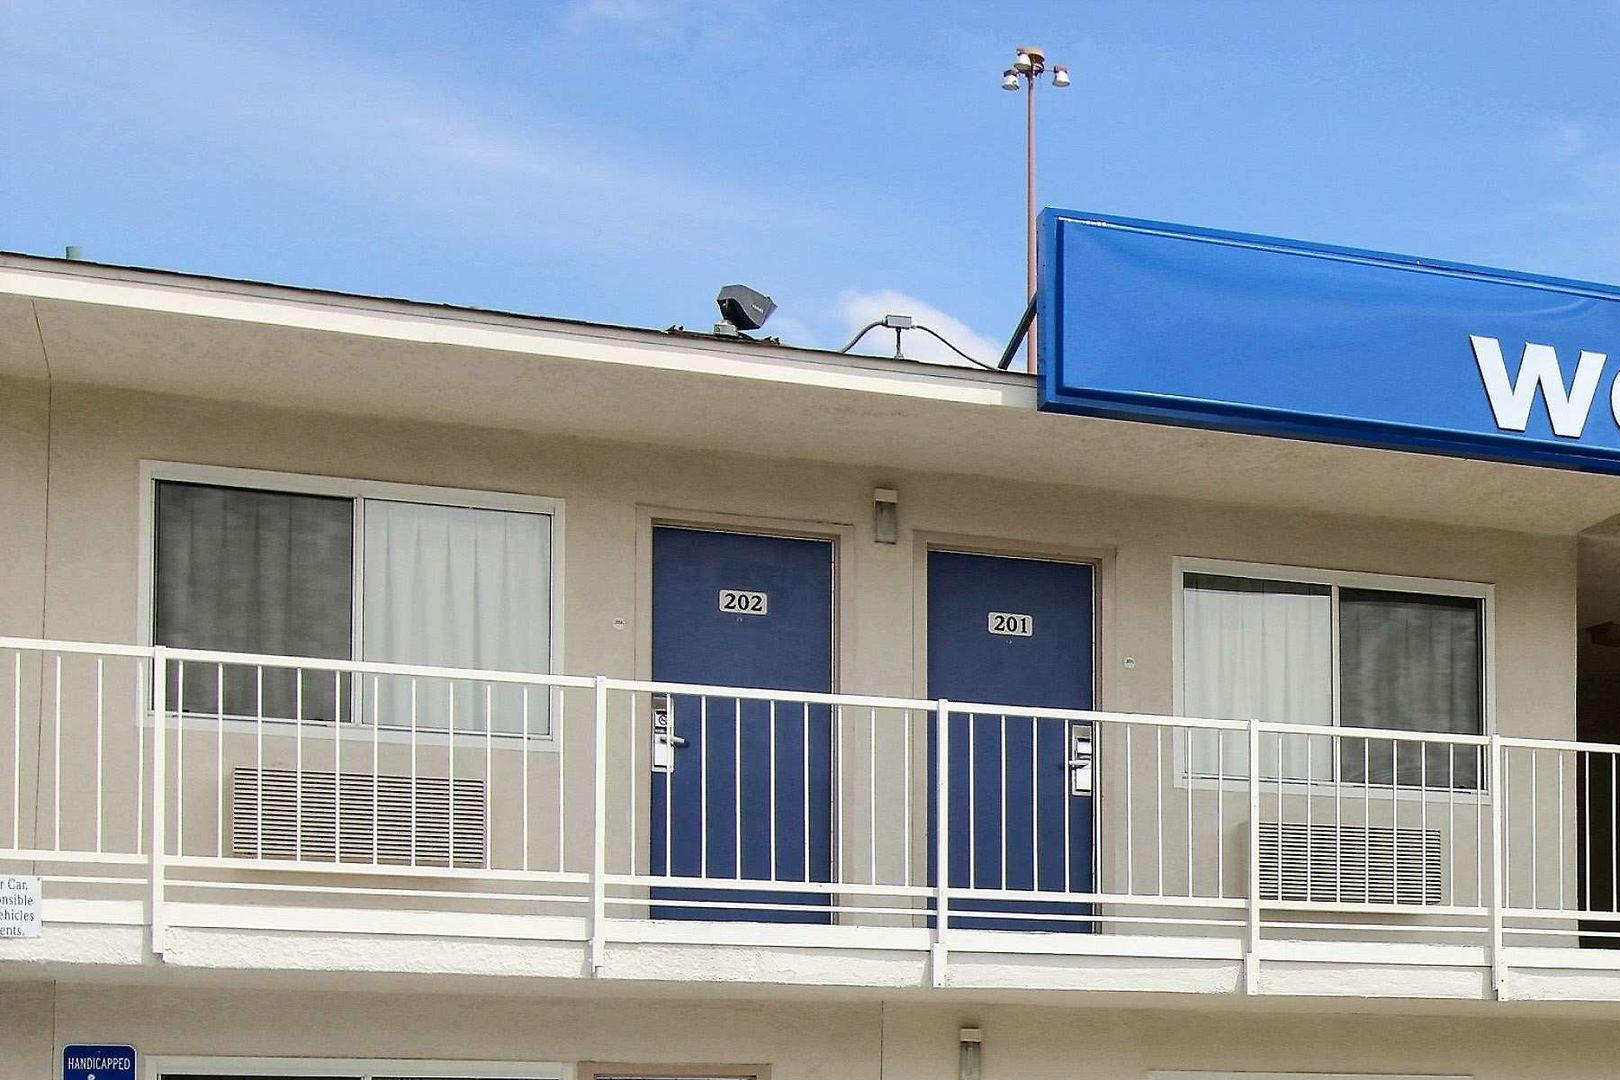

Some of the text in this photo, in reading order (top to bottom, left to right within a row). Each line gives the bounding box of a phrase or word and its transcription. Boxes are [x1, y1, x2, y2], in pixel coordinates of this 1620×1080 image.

[724, 593, 763, 611] 202
[994, 615, 1027, 633] 201
[7, 878, 28, 890] Car.
[0, 894, 33, 906] nsible
[68, 1057, 131, 1070] HANDICAPPED
